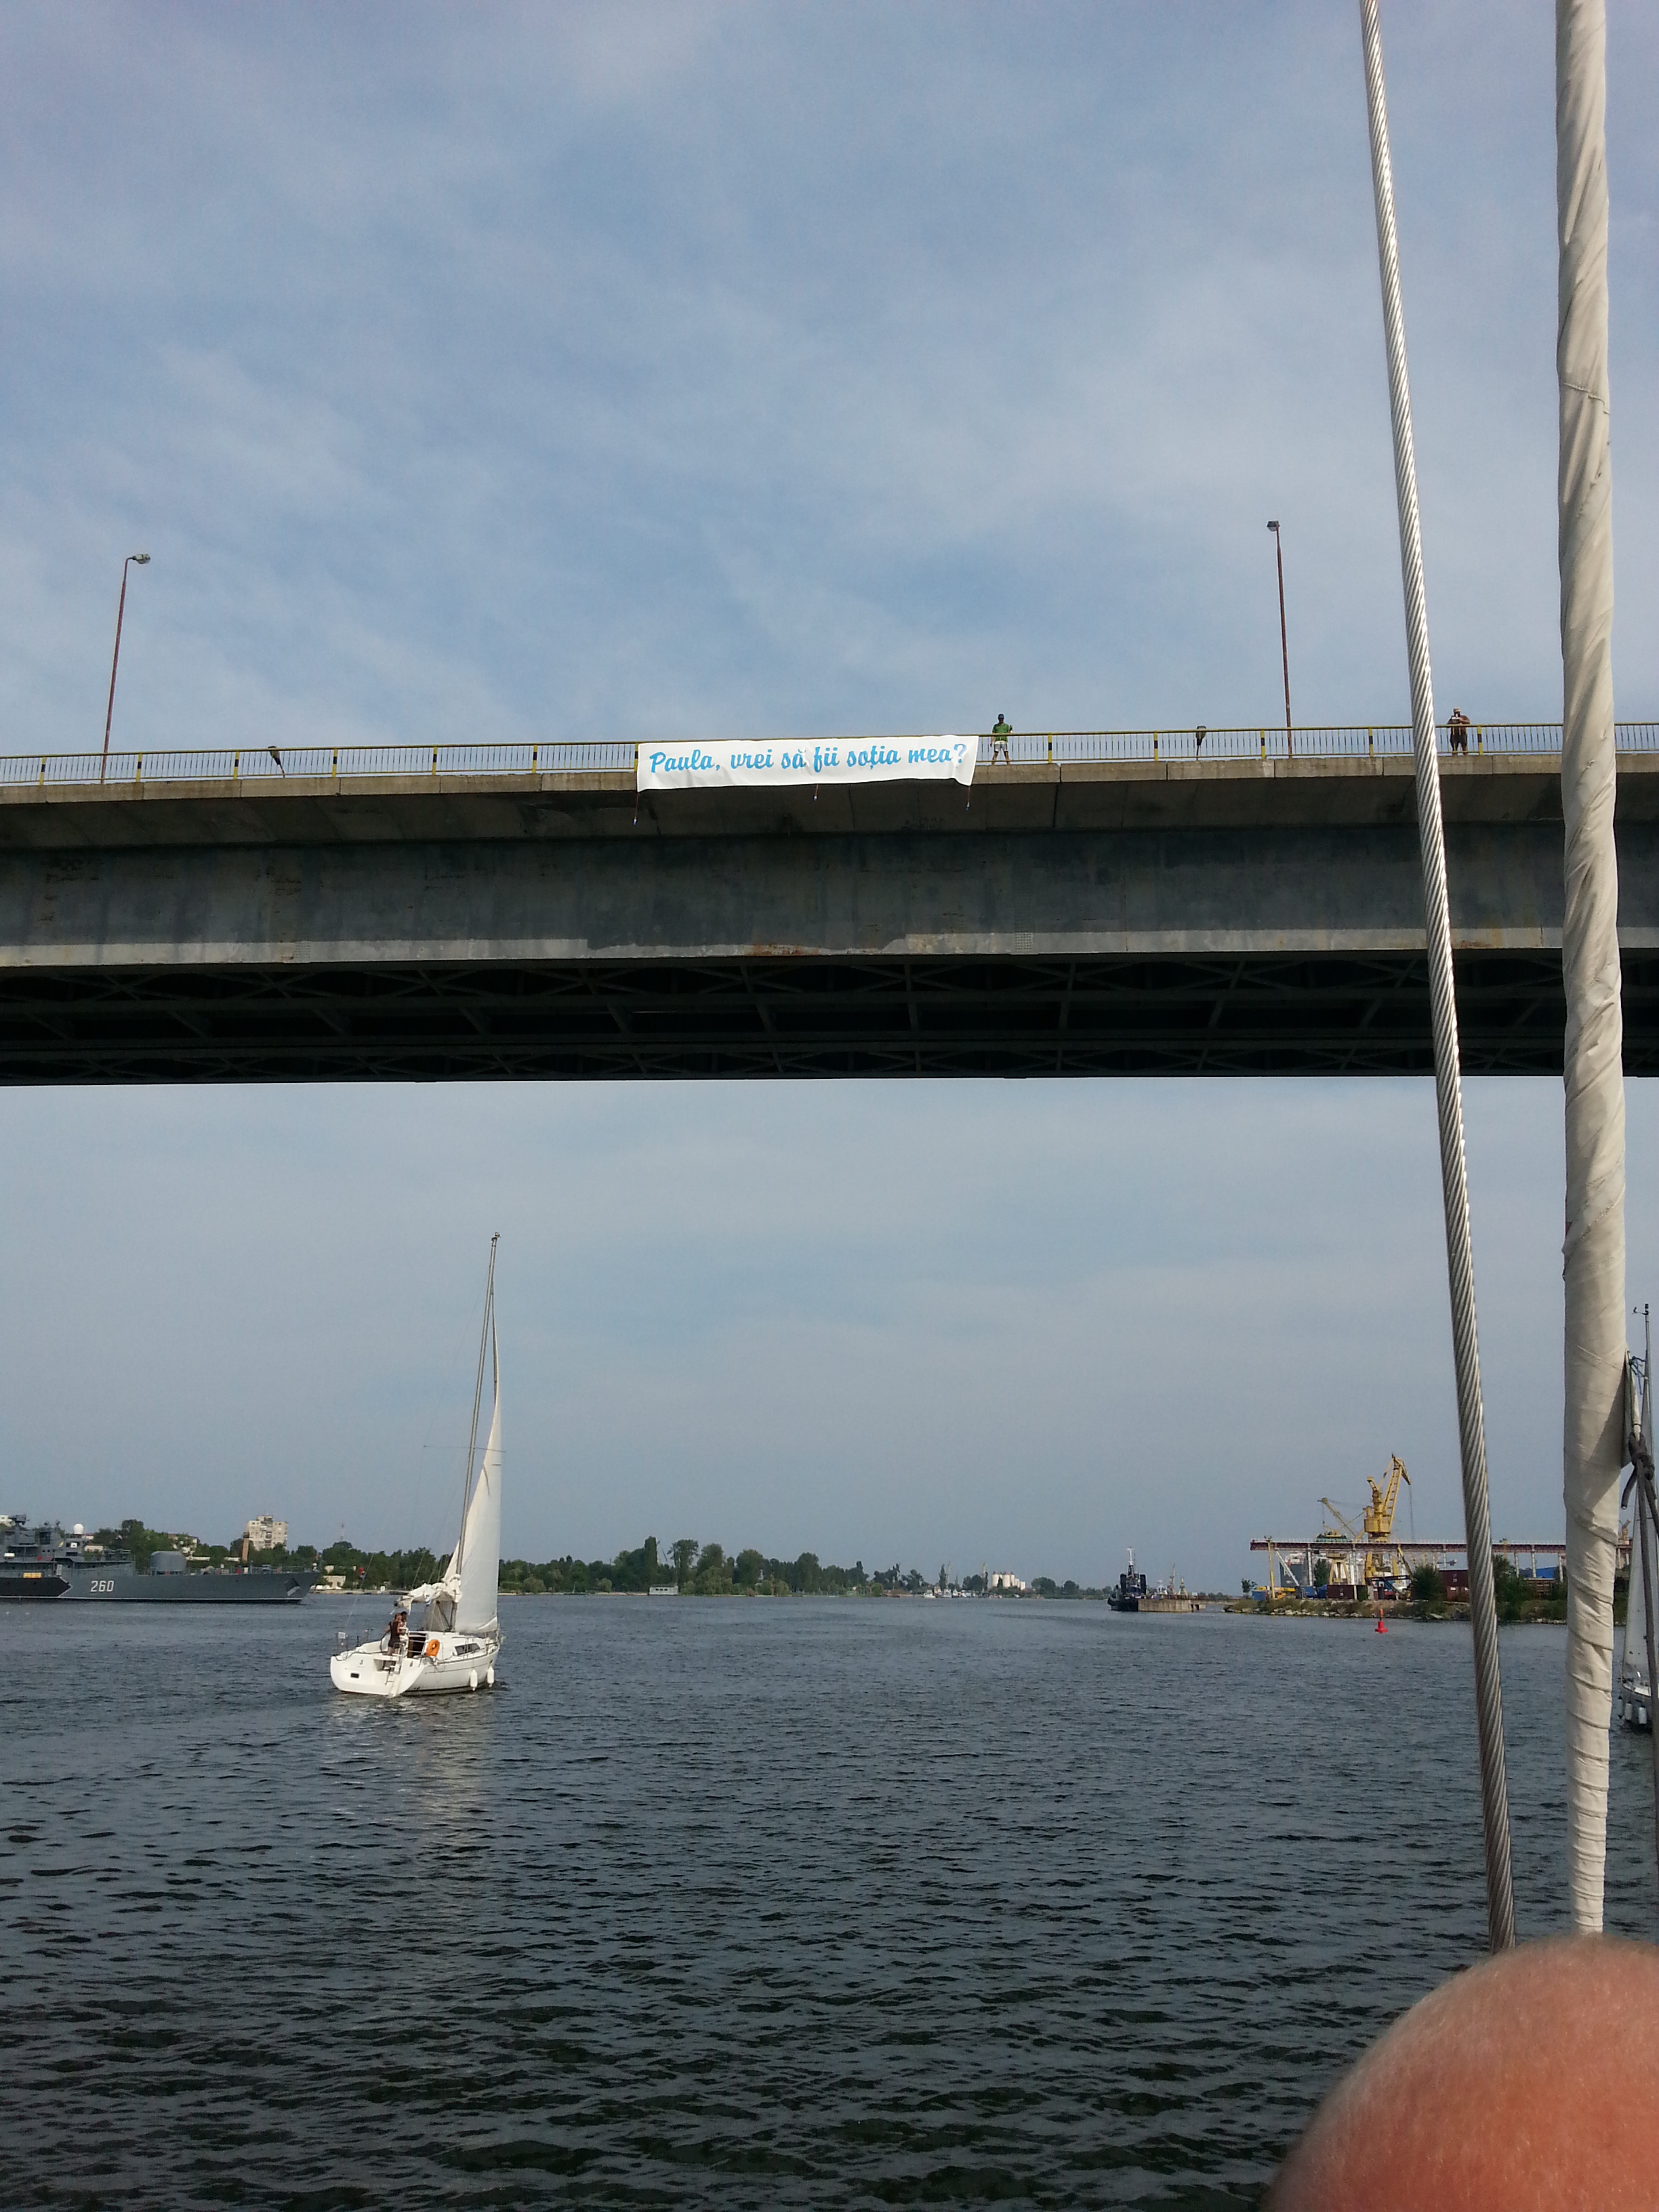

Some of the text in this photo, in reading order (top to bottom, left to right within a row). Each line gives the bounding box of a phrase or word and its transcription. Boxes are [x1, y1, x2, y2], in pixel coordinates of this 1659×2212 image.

[649, 743, 967, 773] Paula, vrei să fii soția mea?
[90, 1580, 115, 1593] 260
